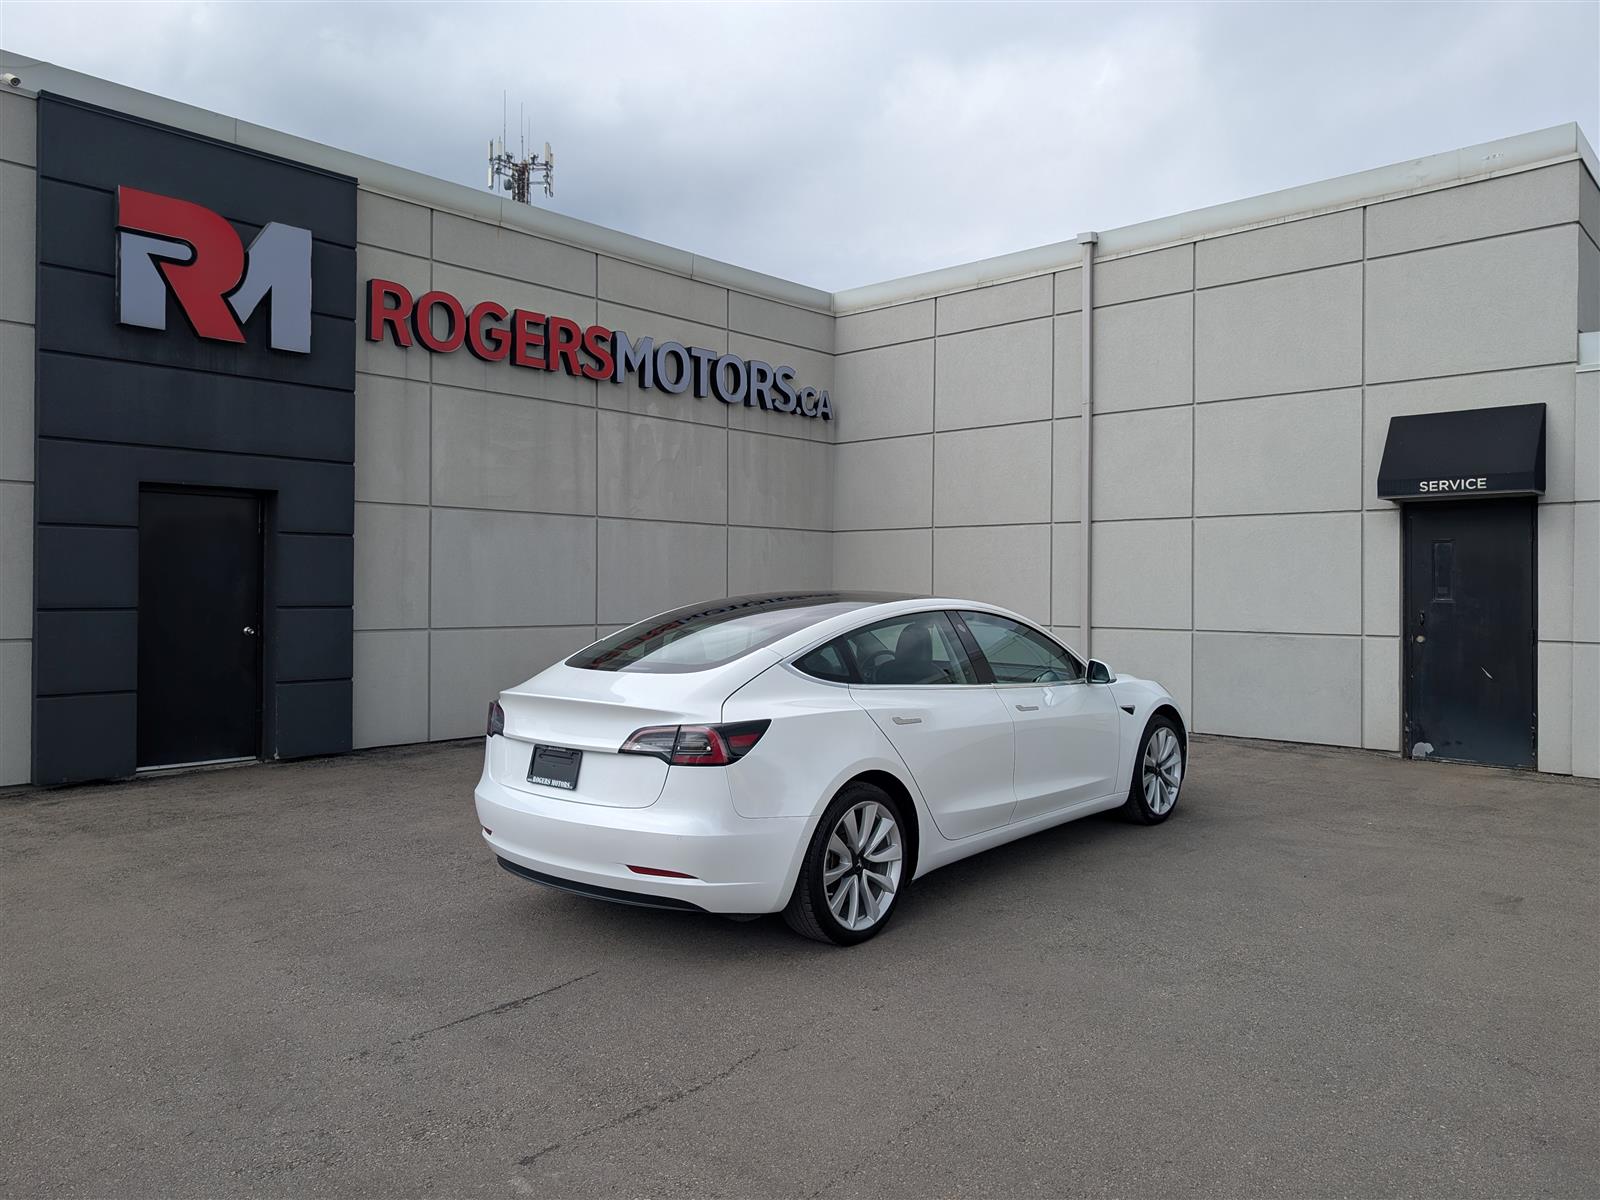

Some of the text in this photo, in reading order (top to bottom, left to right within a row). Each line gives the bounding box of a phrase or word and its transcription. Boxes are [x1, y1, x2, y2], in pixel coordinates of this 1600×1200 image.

[115, 185, 312, 354] RM
[1419, 478, 1487, 492] SERVICE
[532, 776, 551, 786] ROGERS
[551, 779, 570, 788] MOTORS
